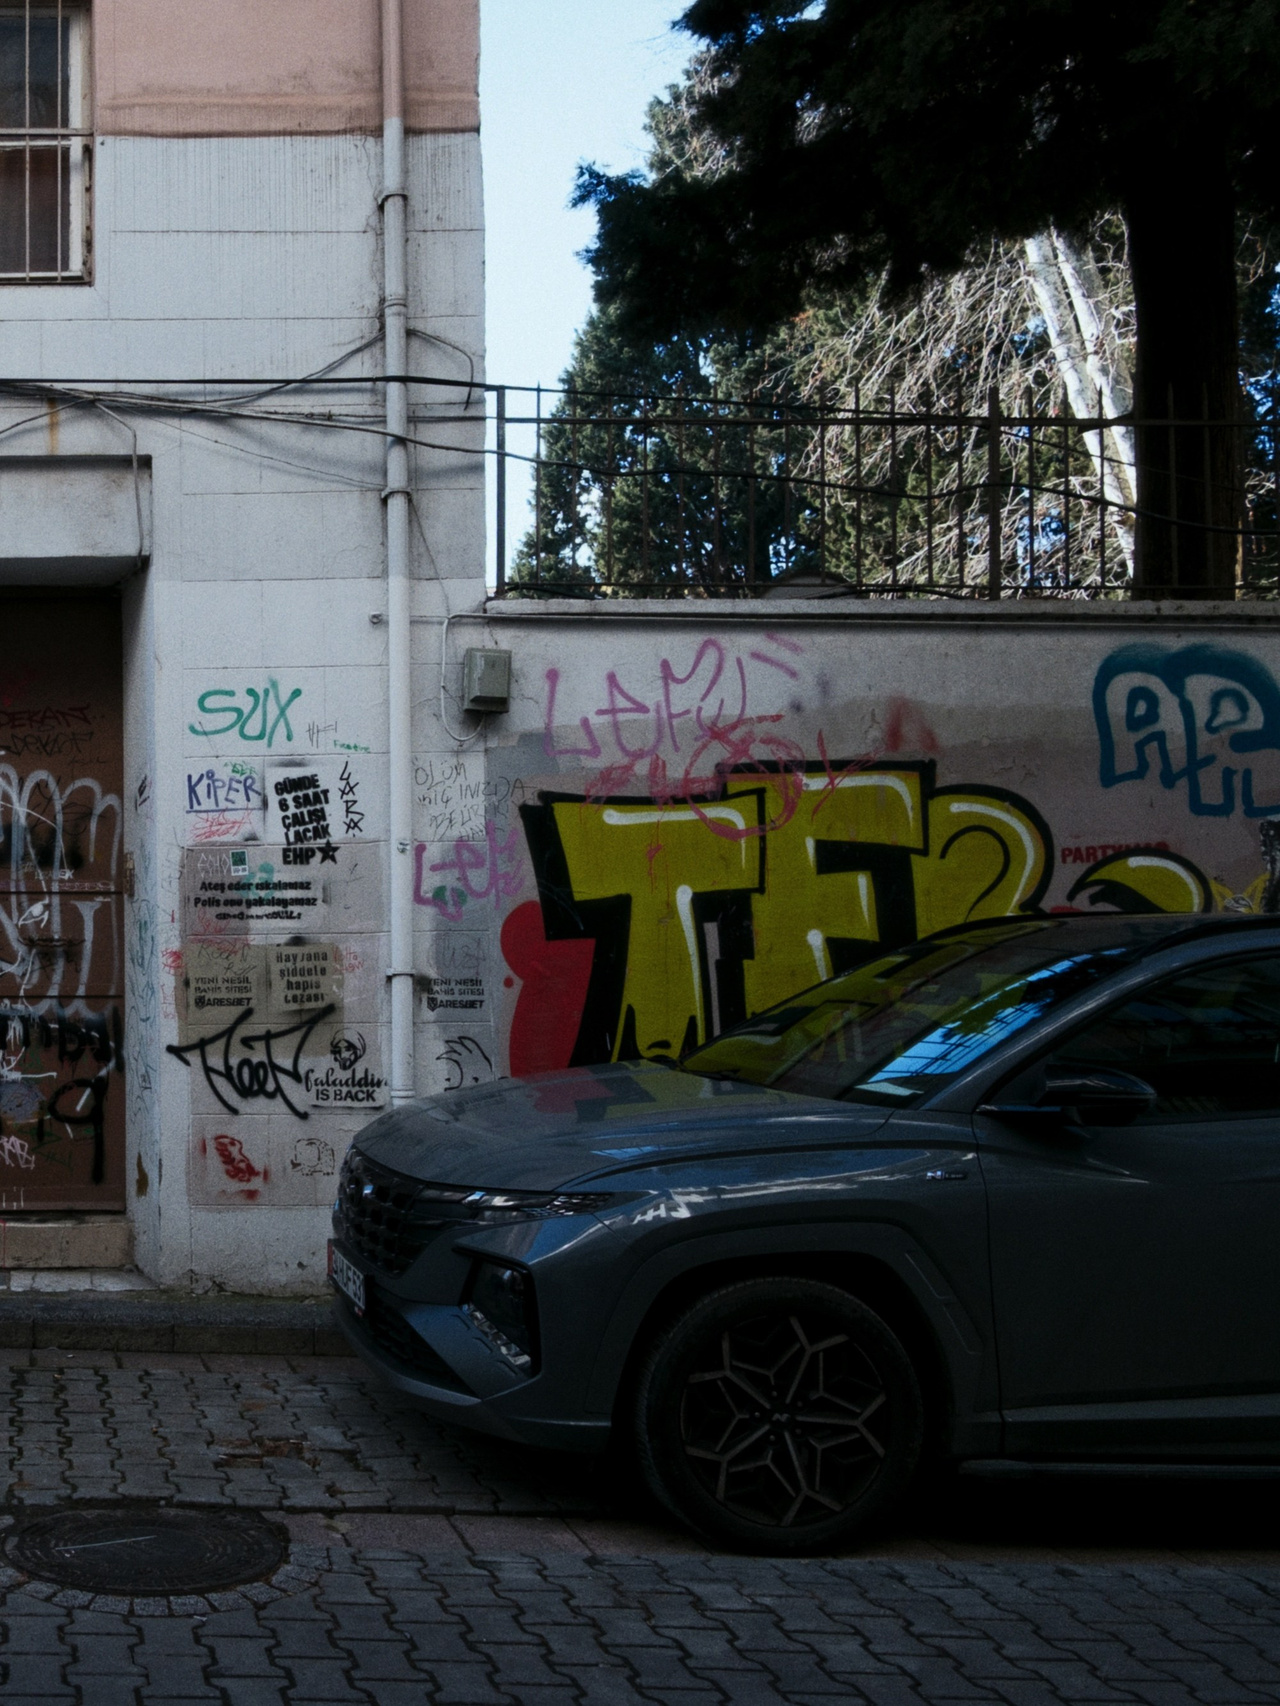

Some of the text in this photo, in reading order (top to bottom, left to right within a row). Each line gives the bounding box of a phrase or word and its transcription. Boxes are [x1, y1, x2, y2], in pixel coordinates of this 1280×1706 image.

[188, 677, 302, 748] SUX
[274, 773, 321, 797] GÜNDE
[278, 788, 330, 813] 6 SAAT
[284, 822, 333, 847] LACAK
[282, 846, 317, 865] EHP
[200, 882, 225, 893] Ateş
[227, 882, 253, 891] eder
[194, 897, 221, 907] Polis
[317, 1089, 376, 1101] IS BACK
